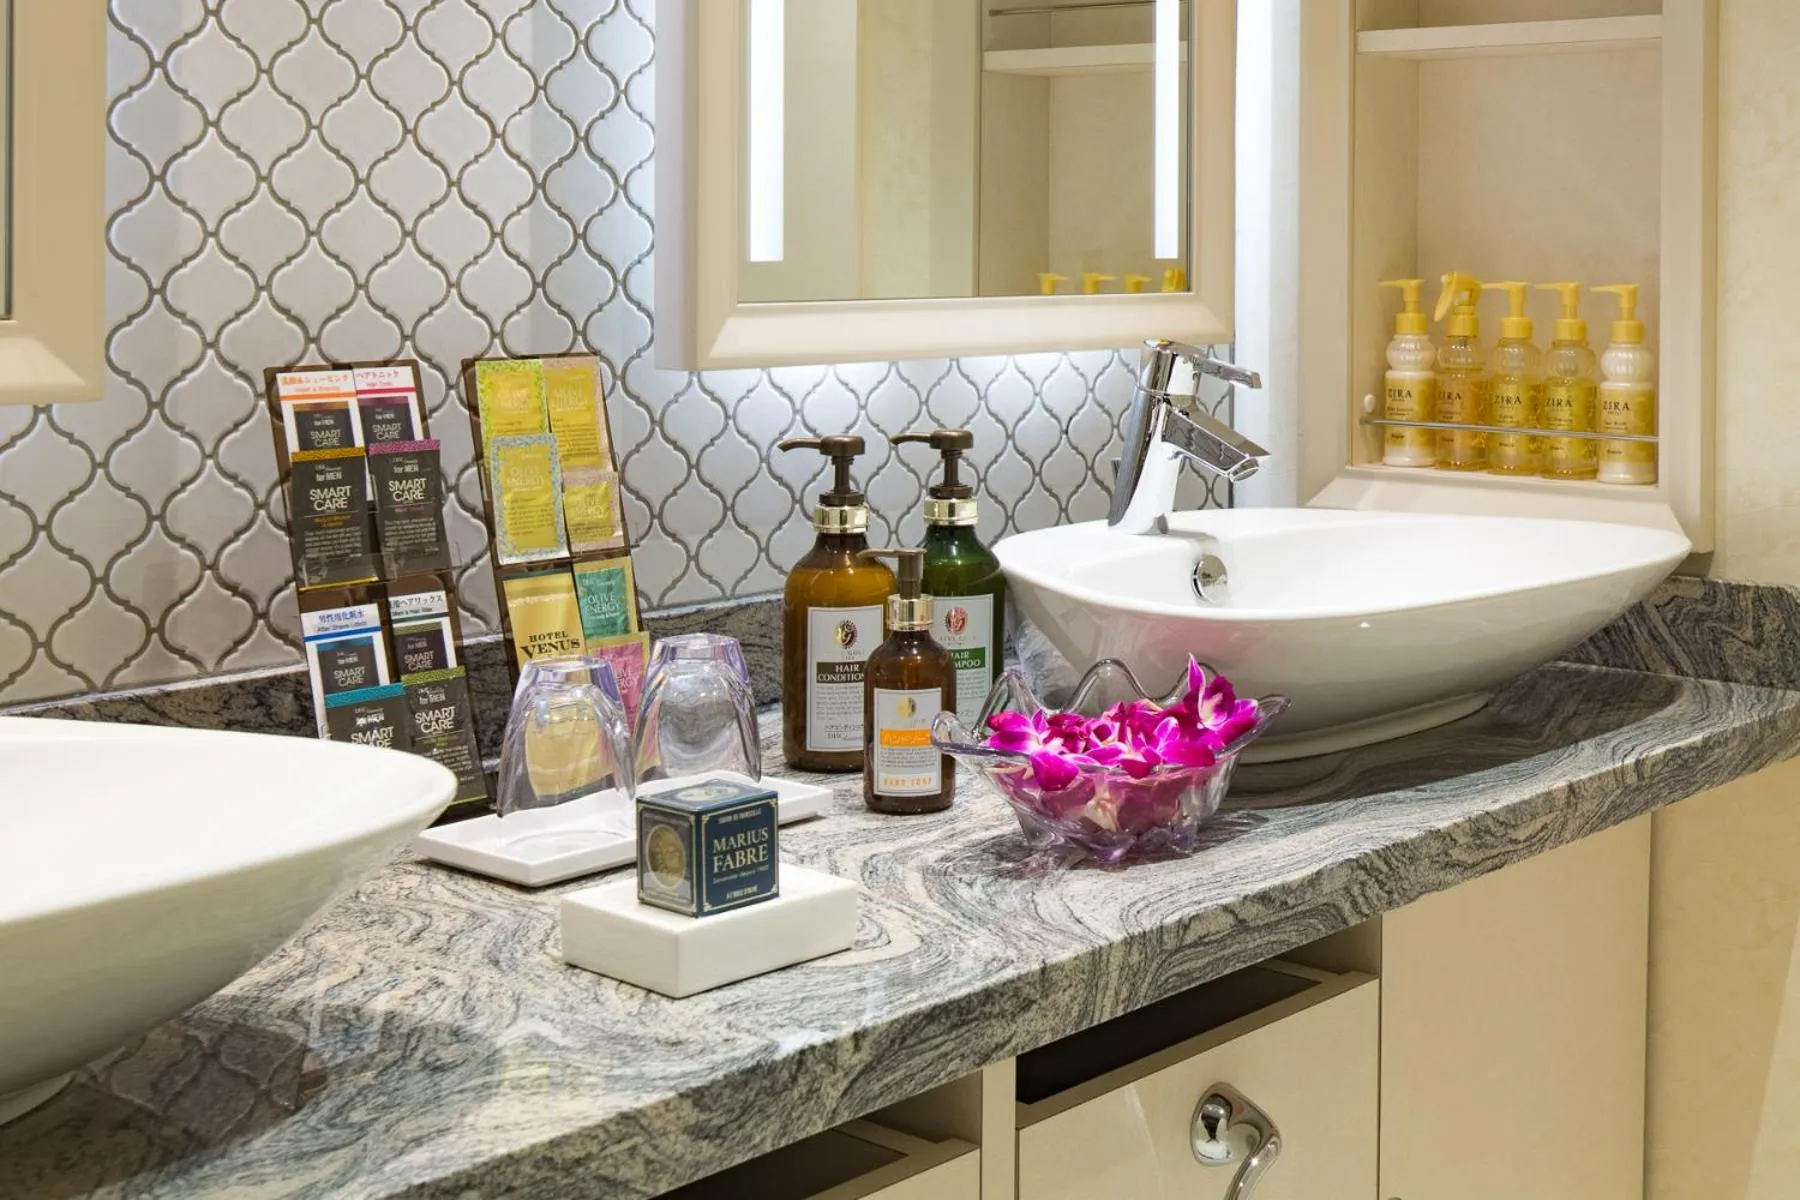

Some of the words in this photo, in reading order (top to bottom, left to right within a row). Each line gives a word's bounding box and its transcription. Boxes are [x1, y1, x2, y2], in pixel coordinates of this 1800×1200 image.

[1388, 388, 1412, 398] ZIRA
[1493, 394, 1522, 405] ZIRA
[1545, 398, 1573, 408] ZIRA
[1602, 400, 1630, 411] ZIRA
[372, 423, 401, 433] SMART
[310, 429, 341, 440] SMART
[376, 431, 401, 440] CARE
[314, 437, 341, 447] CARE
[326, 471, 343, 480] MEN
[388, 478, 427, 492] SMART
[309, 485, 352, 501] SMART
[393, 489, 424, 502] CARE
[313, 498, 348, 511] CARE
[588, 592, 615, 604] OLIVE
[528, 630, 569, 642] HOTEL
[520, 638, 581, 659] VENUS
[404, 650, 434, 664] SMART
[408, 660, 433, 670] CARE
[835, 664, 859, 672] HAIR
[334, 666, 365, 679] SMART
[338, 675, 364, 687] CARE
[414, 706, 456, 723] SMART
[420, 720, 454, 733] CARE
[350, 726, 395, 745] SMART
[368, 739, 393, 749] ARE
[712, 827, 768, 853] MARIUS
[713, 844, 768, 873] FABRE
